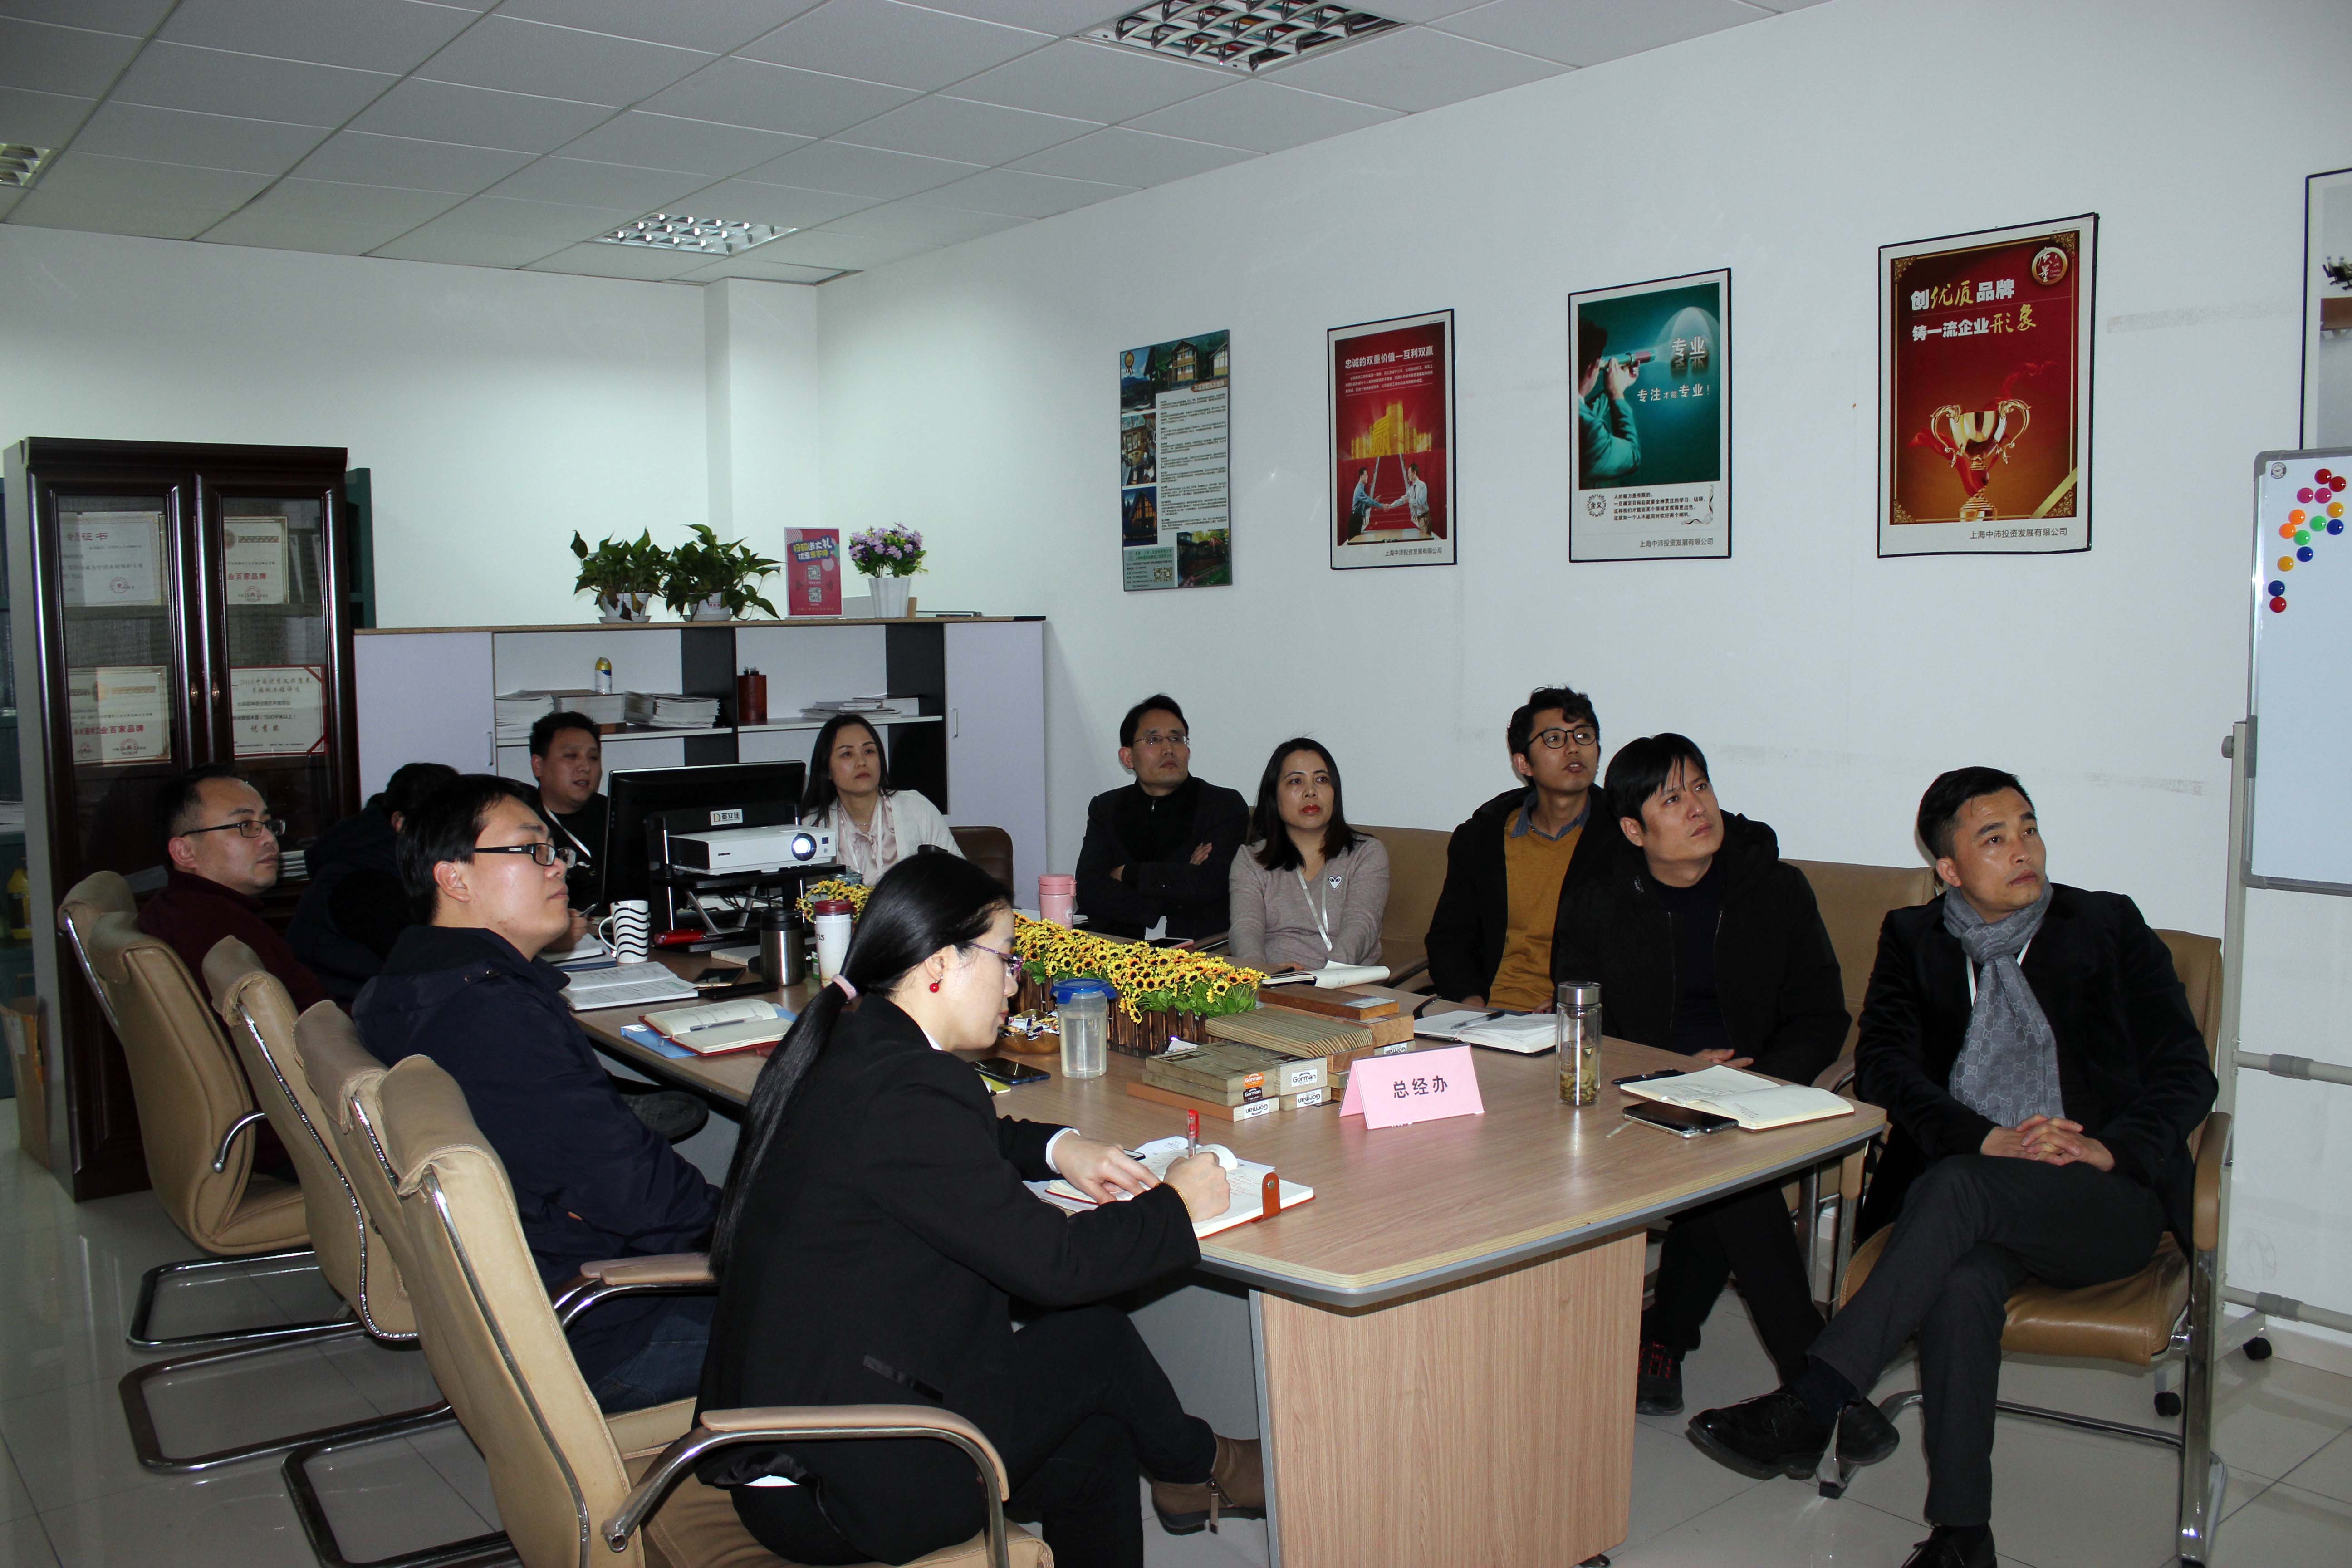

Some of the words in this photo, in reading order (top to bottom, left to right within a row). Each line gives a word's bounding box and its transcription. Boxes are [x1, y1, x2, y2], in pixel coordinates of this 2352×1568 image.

[1911, 279, 2015, 311] 创优质品牌
[1912, 304, 2037, 341] 铸一流企业形象
[1671, 336, 1705, 357] 专业
[1293, 1074, 1316, 1083] Gorman
[1393, 1075, 1448, 1098] 总经办
[1245, 1104, 1268, 1113] Gorman
[1298, 1094, 1320, 1102] Gorman
